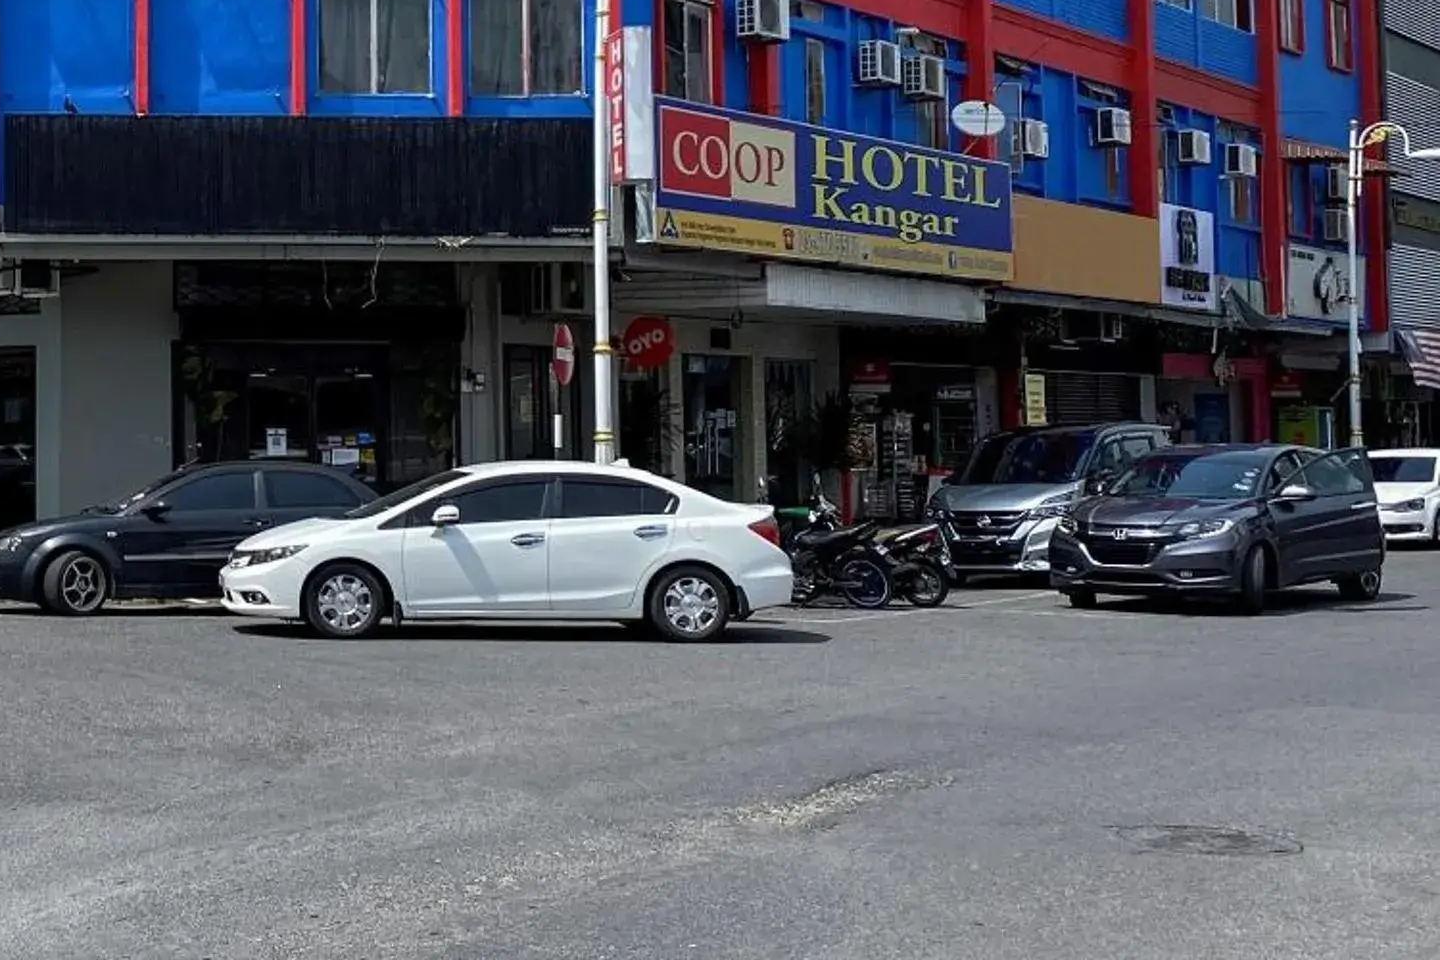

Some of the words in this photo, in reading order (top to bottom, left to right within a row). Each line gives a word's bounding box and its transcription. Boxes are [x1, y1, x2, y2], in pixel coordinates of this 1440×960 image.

[610, 38, 624, 176] HOTEL
[672, 130, 785, 187] COOP
[811, 133, 1001, 209] HOTEL
[811, 183, 960, 244] Kangar
[628, 327, 665, 355] OYO
